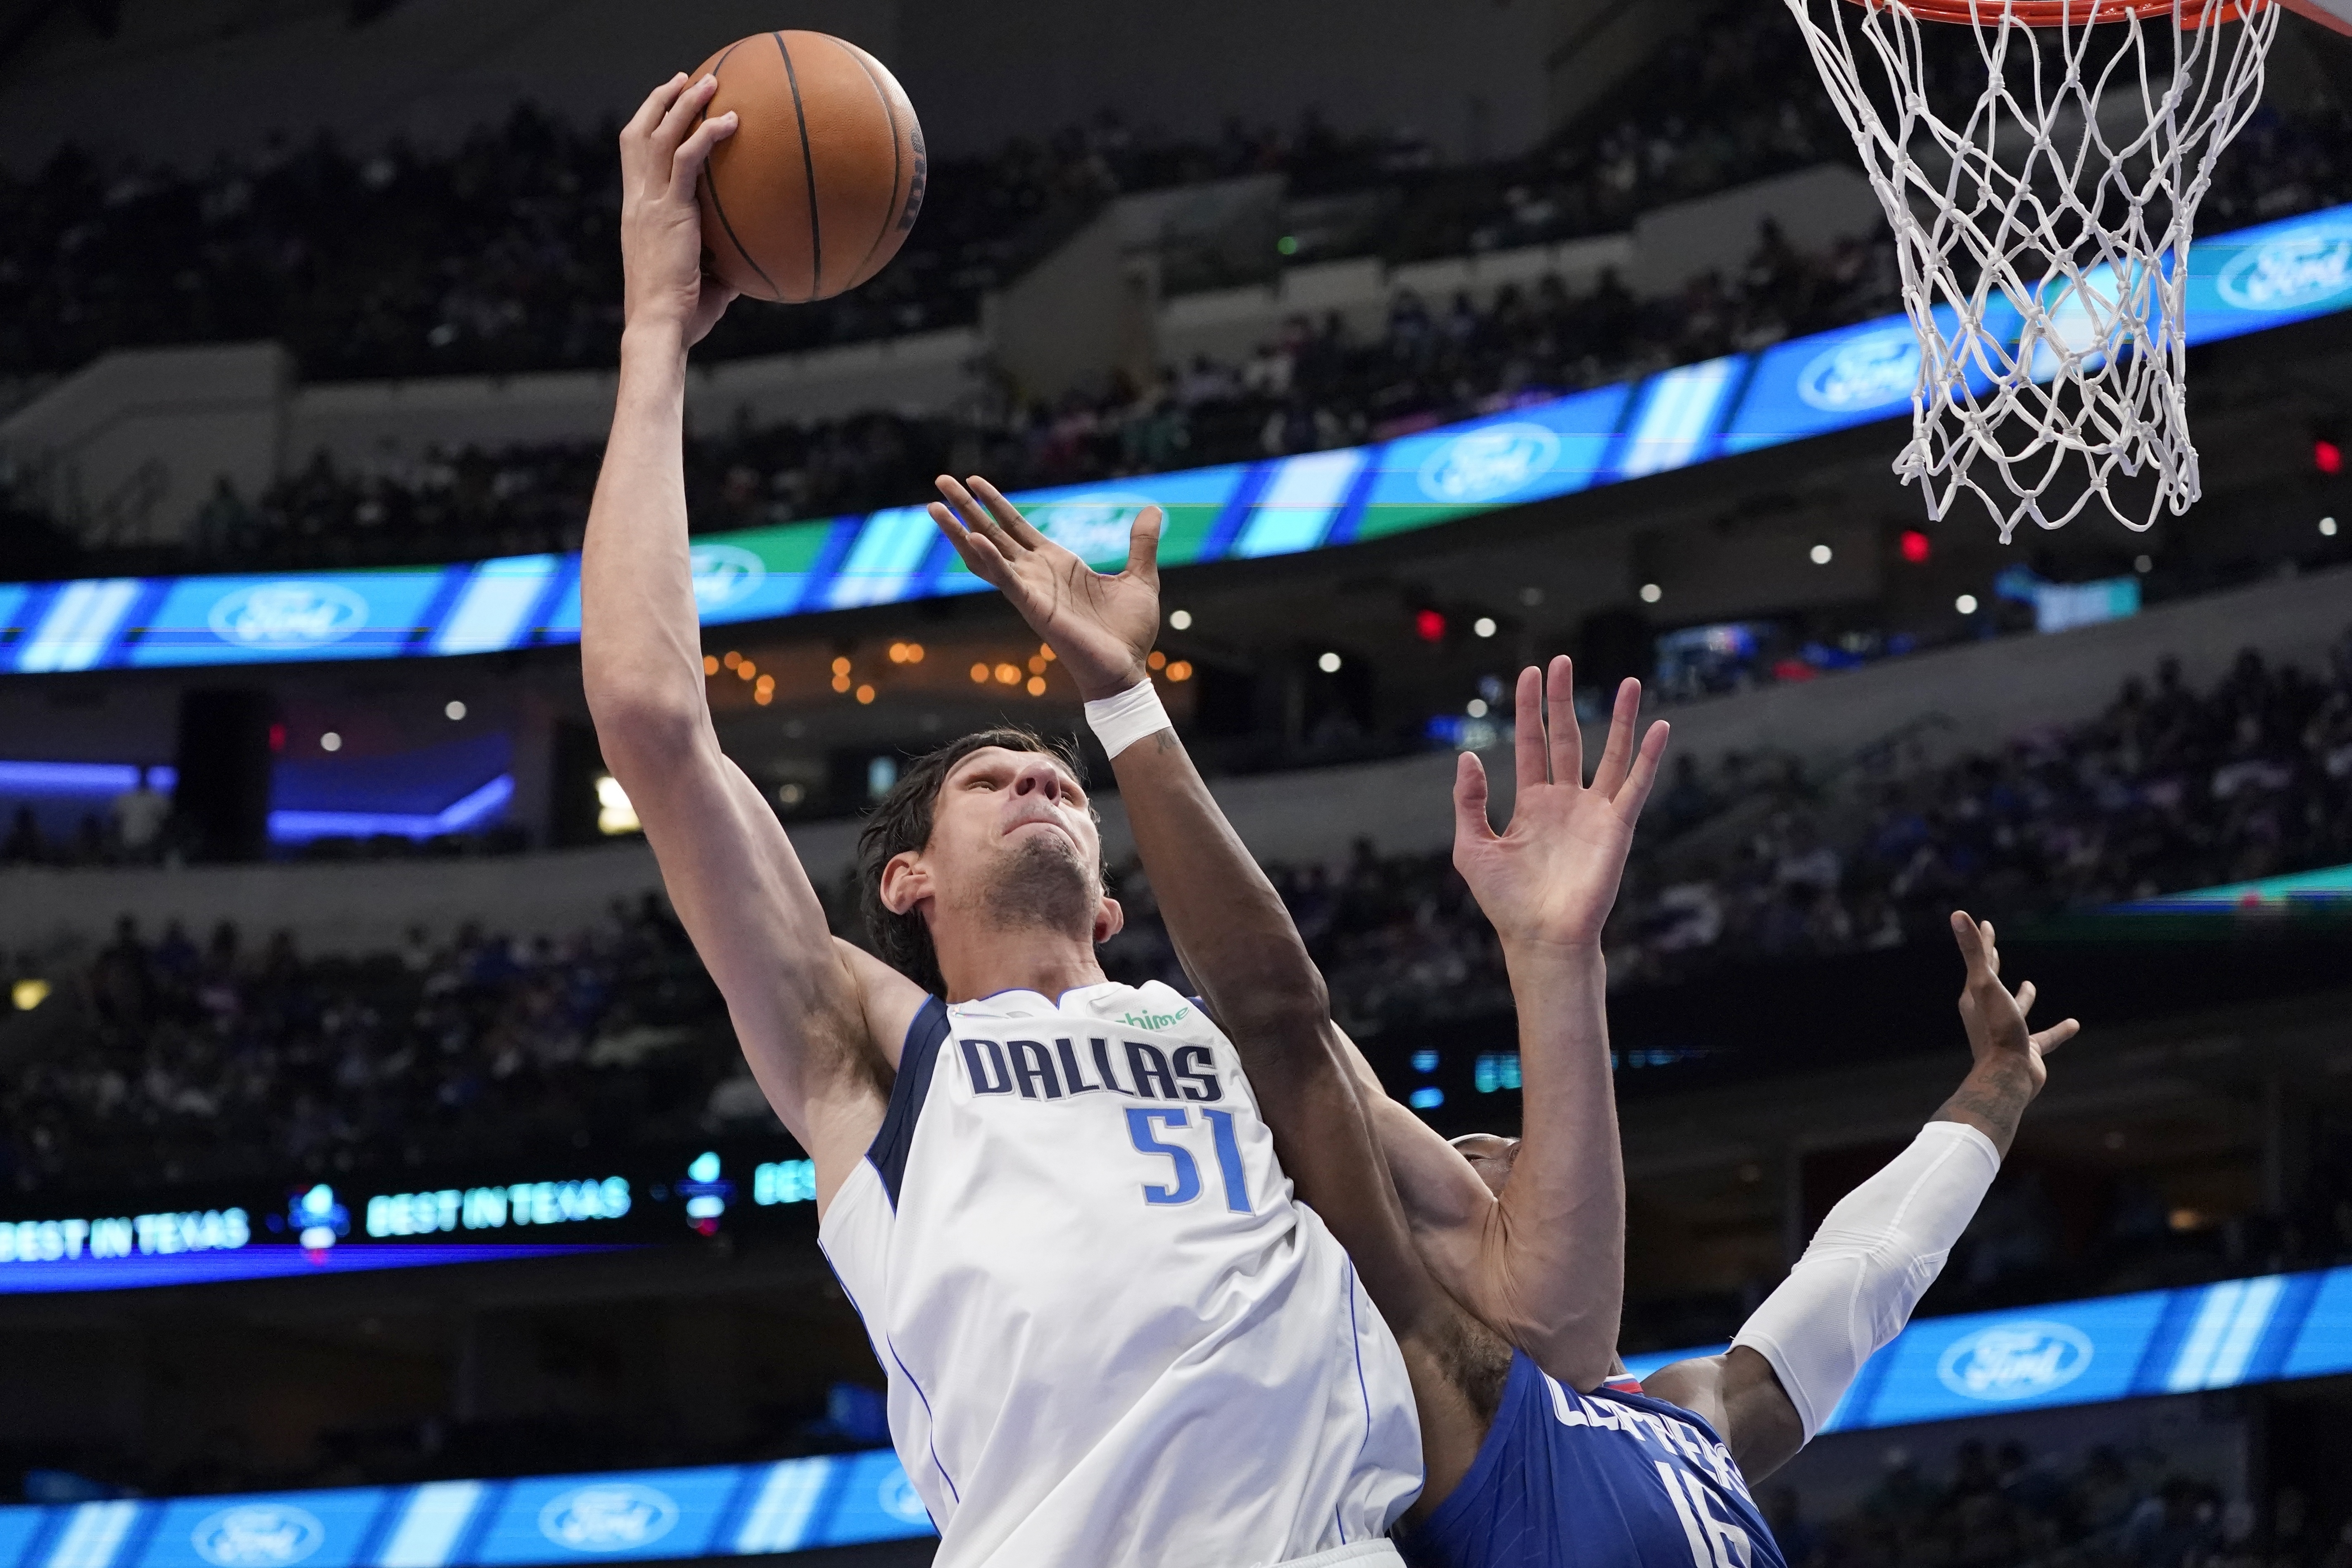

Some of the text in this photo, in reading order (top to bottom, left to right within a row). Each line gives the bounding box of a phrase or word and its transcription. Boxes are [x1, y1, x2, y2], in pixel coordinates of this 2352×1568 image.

[2247, 235, 2350, 302] Ford
[1114, 1007, 1190, 1030] hime
[956, 1036, 1225, 1103] DALLAS
[1123, 1105, 1256, 1216] 51
[90, 1216, 133, 1259] IN
[133, 1207, 251, 1256] TEXAS
[366, 1176, 632, 1238] BEST IN TEXAS
[1963, 1330, 2065, 1392] Ford
